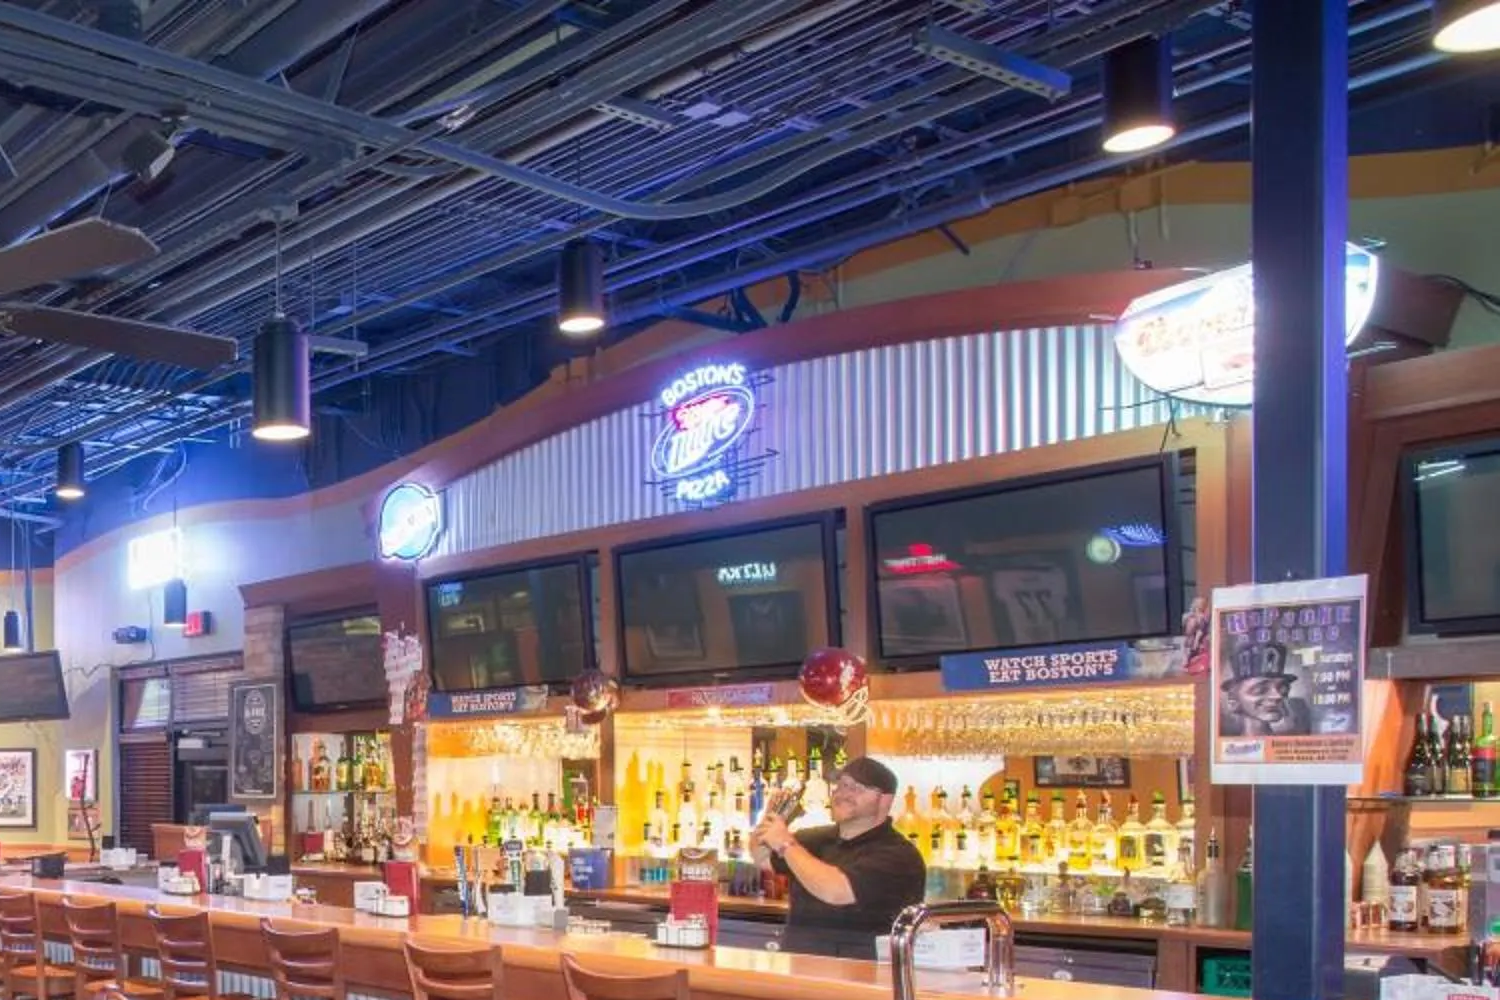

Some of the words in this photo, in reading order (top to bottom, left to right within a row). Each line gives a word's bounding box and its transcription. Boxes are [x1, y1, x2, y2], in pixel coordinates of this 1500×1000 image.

[662, 363, 746, 407] BOSTON'S
[675, 470, 730, 500] PIZZA
[984, 654, 1047, 671] WATCH
[1050, 650, 1118, 666] SPORTS
[989, 668, 1021, 683] EAT
[1025, 664, 1114, 681] BOSTON'S
